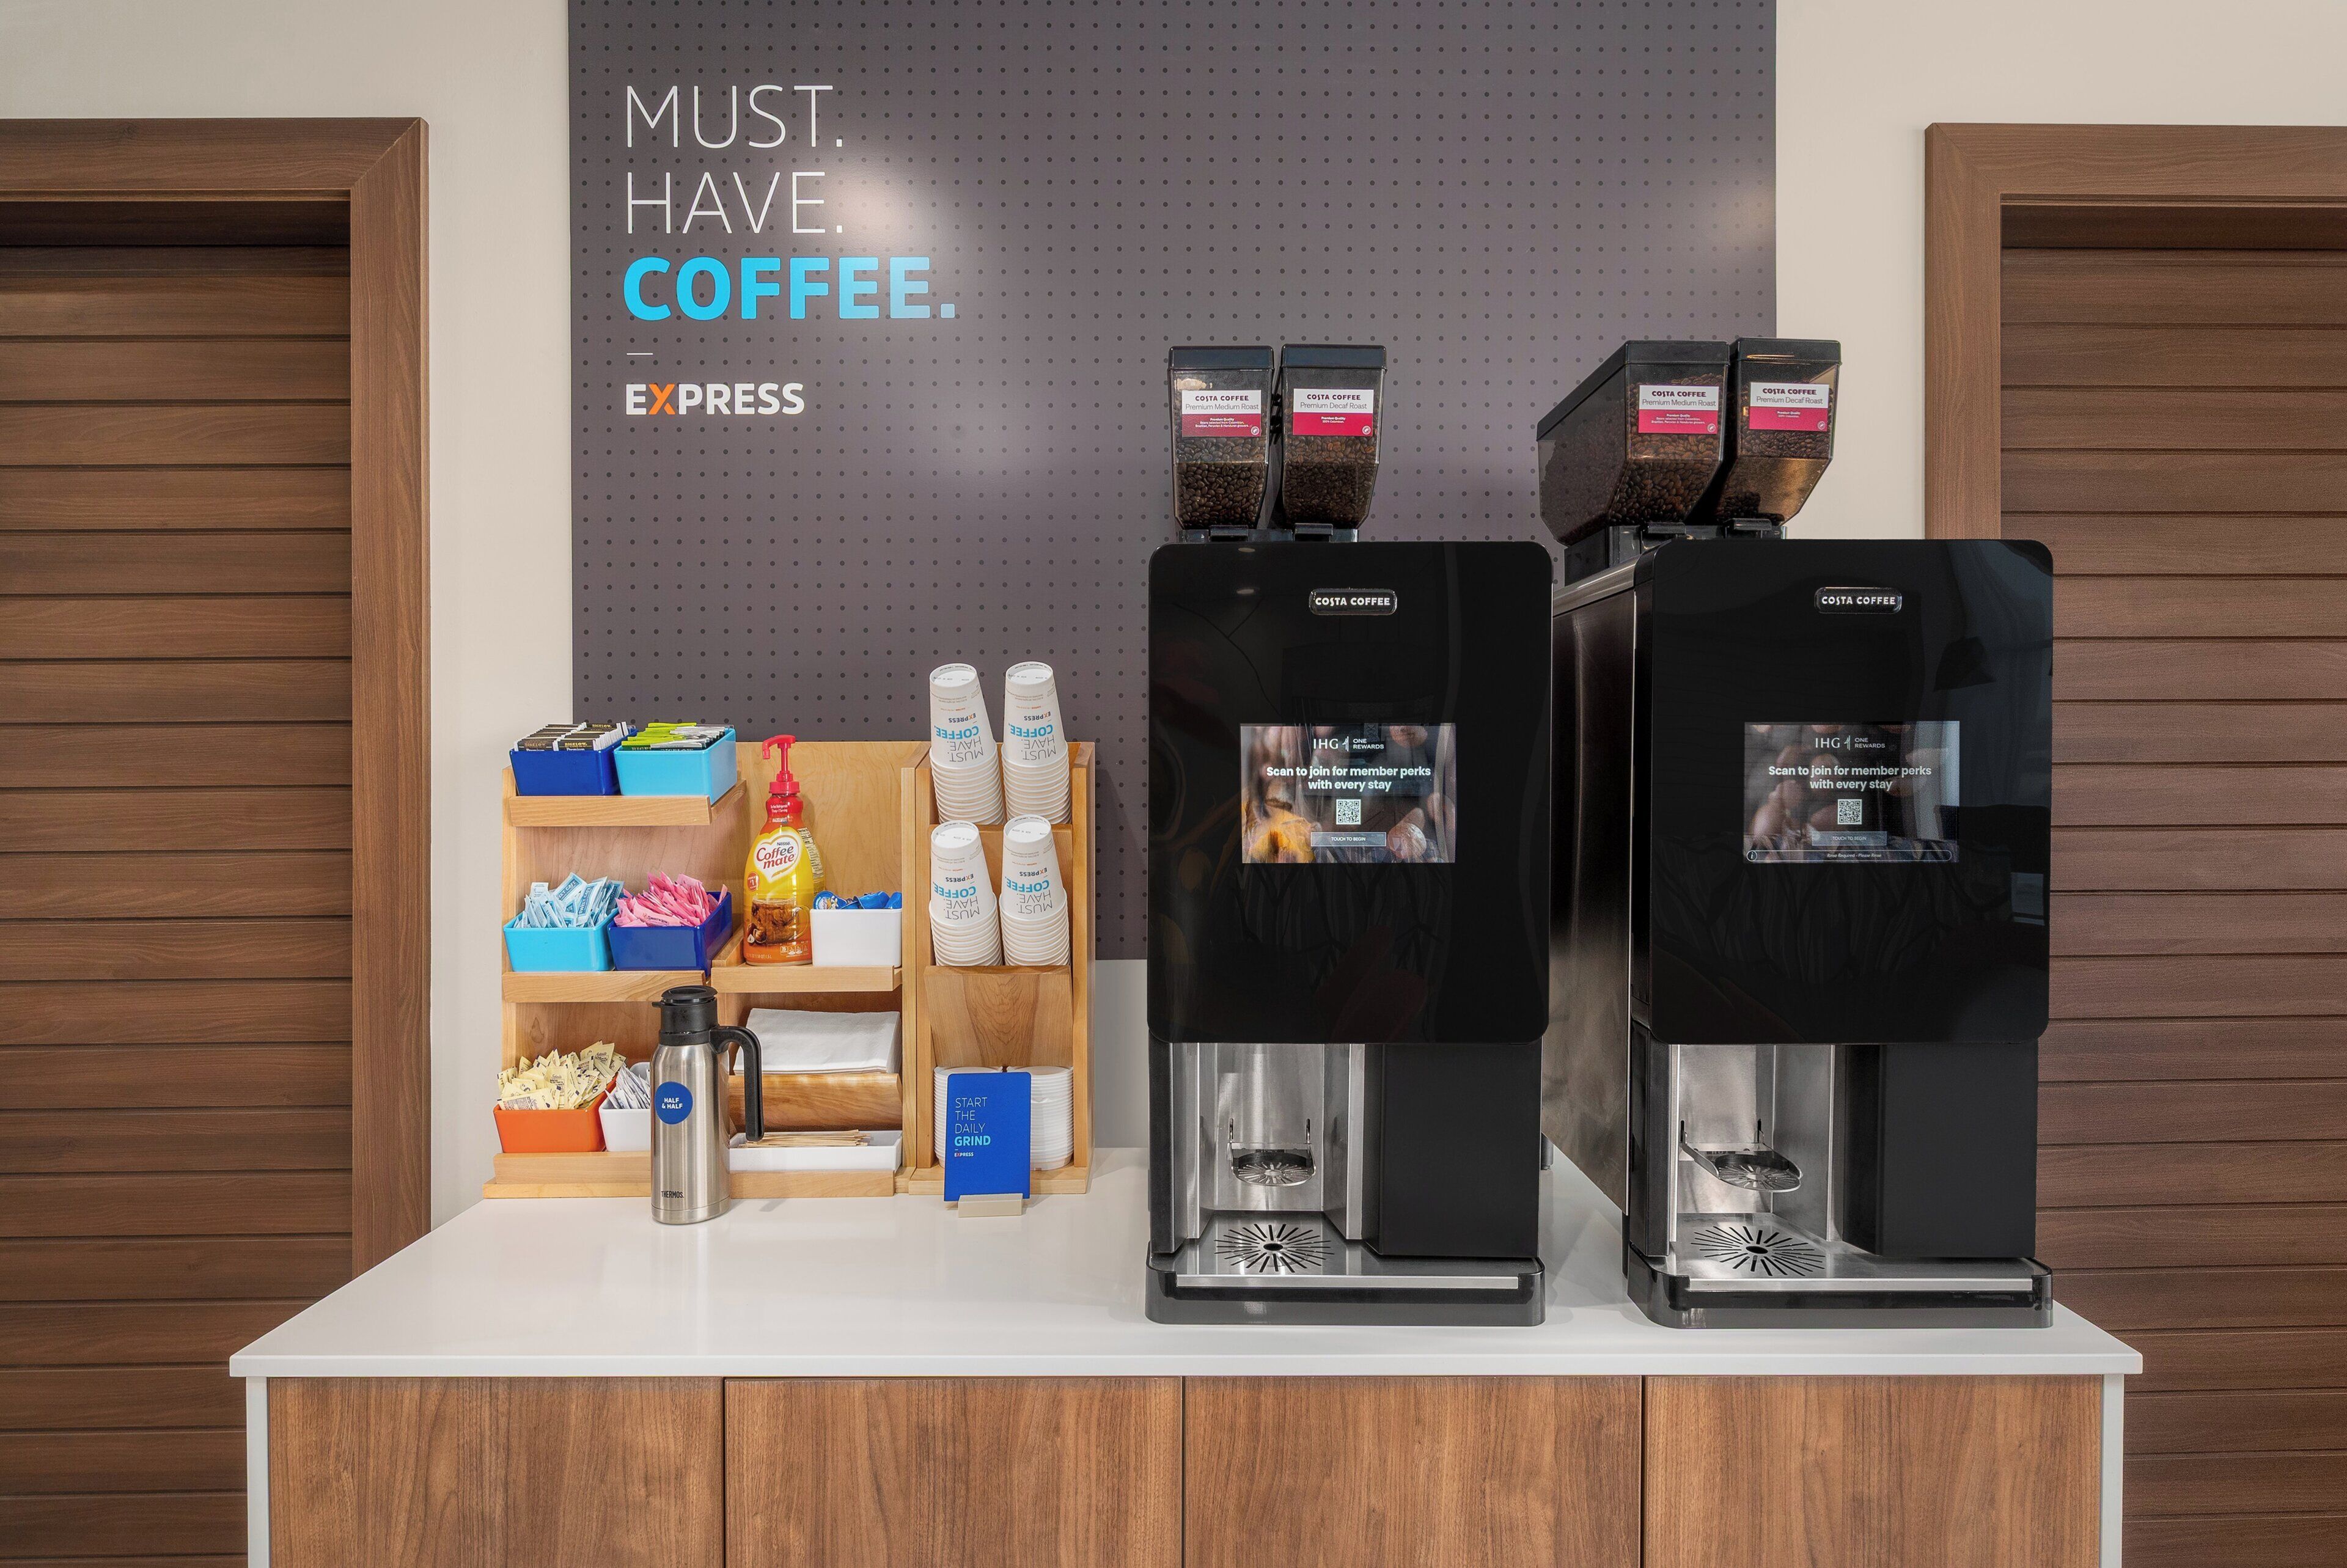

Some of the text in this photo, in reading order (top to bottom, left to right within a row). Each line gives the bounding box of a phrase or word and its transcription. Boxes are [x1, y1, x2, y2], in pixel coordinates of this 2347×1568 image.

[627, 85, 843, 148] MUST.
[627, 172, 843, 234] HAVE.
[623, 255, 955, 321] COFFEE.
[626, 383, 805, 415] EXPRESS
[1315, 598, 1347, 606] COSTA
[1821, 596, 1896, 605] COSTA COFFEE
[949, 713, 976, 722] EXPRESS
[1024, 711, 1051, 720] EXPRESS
[934, 725, 979, 740] COFFEE.
[1008, 723, 1053, 738] COFFEE.
[947, 736, 982, 751] HAVE.
[1021, 735, 1055, 749] HAVE.
[1313, 738, 1339, 749] IHG
[1815, 738, 1841, 749] IHG
[947, 747, 983, 763] MUST.
[1021, 746, 1056, 761] MUST.
[1266, 766, 1431, 779] Scan to join for member perks
[1769, 766, 1931, 778] Scan to join for member perks
[1308, 780, 1392, 792] with every stay
[1810, 780, 1893, 792] with every stay
[757, 846, 793, 862] Coffee
[763, 853, 795, 869] mate
[946, 873, 974, 882] EXPRESS
[1019, 867, 1047, 877] EXPRESS
[933, 881, 977, 898] COFFEE.
[1005, 876, 1050, 892] COFFEE.
[943, 896, 978, 909] HAVE.
[1016, 890, 1051, 904] HAVE.
[943, 906, 980, 920] MUST.
[1016, 899, 1052, 914] MUST.
[955, 1097, 988, 1108] START
[955, 1110, 975, 1121] THE
[955, 1123, 985, 1134] DAILY
[955, 1135, 991, 1146] GRIND
